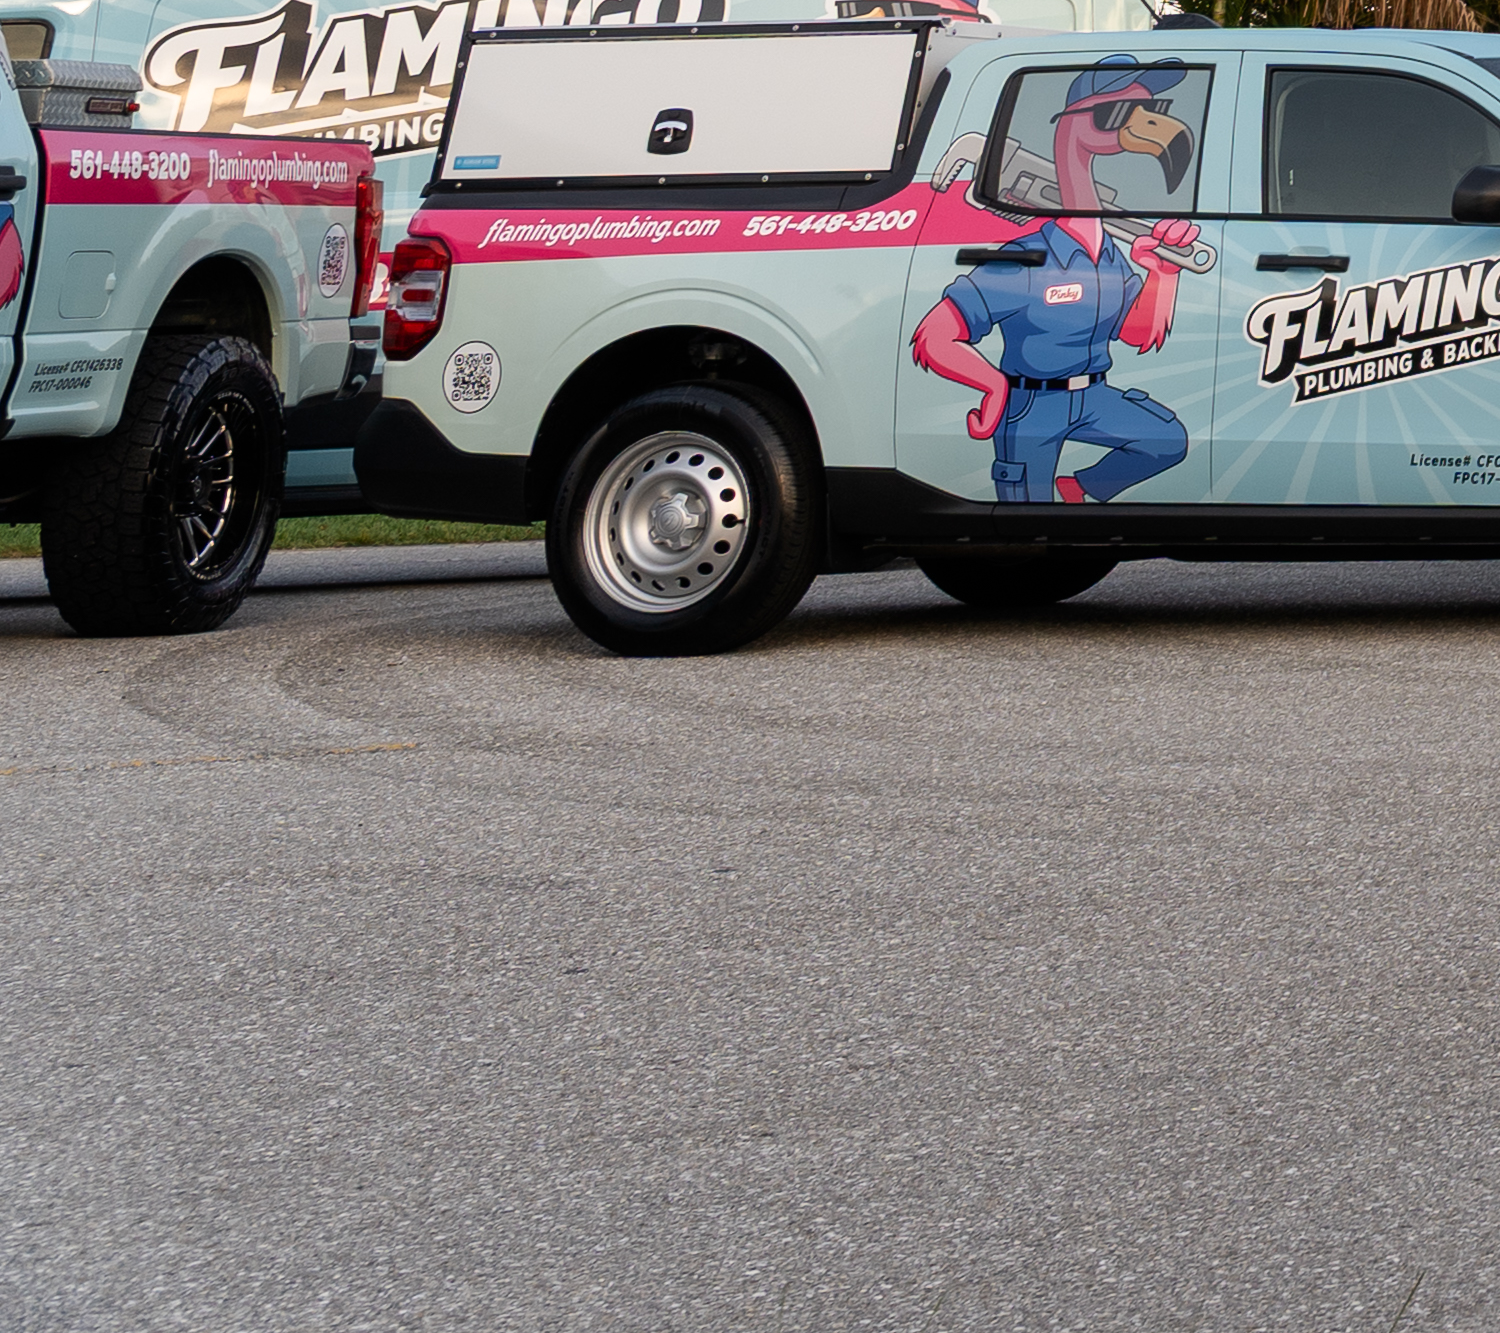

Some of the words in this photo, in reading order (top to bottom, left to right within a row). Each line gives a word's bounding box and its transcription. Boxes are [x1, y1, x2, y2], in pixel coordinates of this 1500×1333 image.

[69, 149, 191, 181] 561-448-3200
[207, 148, 348, 189] flamingoplumbing.com
[477, 215, 721, 249] flamingoplumbing.com
[743, 209, 918, 238] 561-448-3200
[1049, 287, 1079, 301] Pinky
[34, 361, 71, 376] License#
[70, 357, 124, 373] CFC1426338
[1303, 349, 1414, 397] PLUMBING
[1420, 347, 1435, 371] &
[28, 376, 93, 393] FPC17-000046
[1410, 453, 1472, 467] License#
